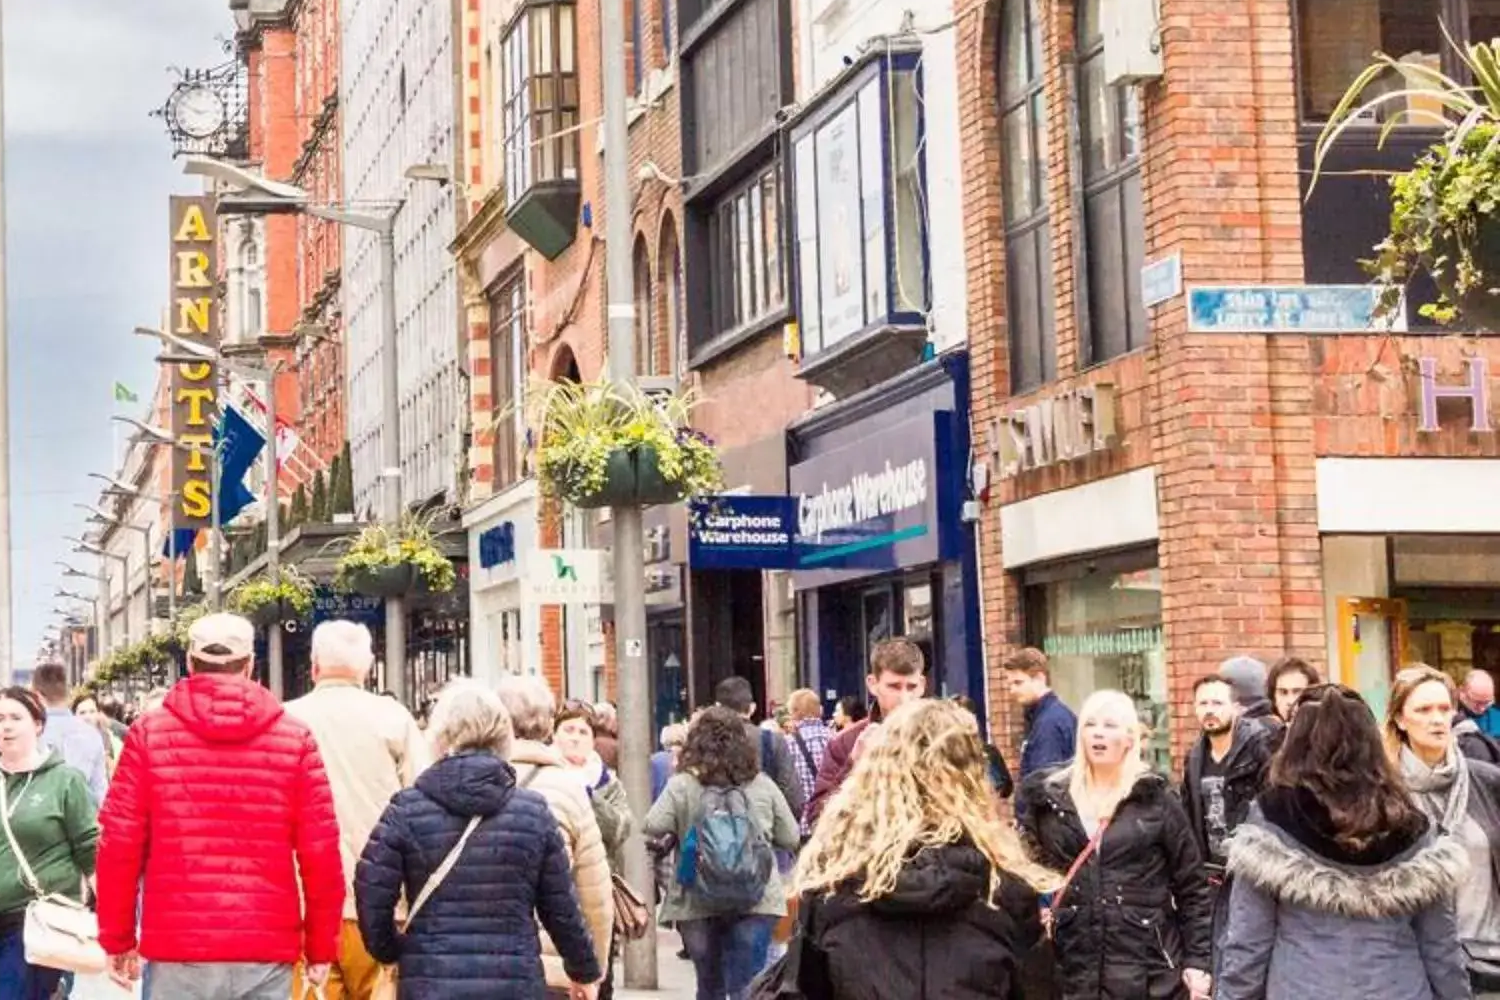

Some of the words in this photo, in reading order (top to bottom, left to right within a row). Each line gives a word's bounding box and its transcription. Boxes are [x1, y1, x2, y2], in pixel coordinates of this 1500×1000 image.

[799, 481, 853, 544] Carphone
[851, 458, 927, 522] Warehouse
[705, 514, 781, 532] Carphone
[700, 532, 789, 544] Warehouse
